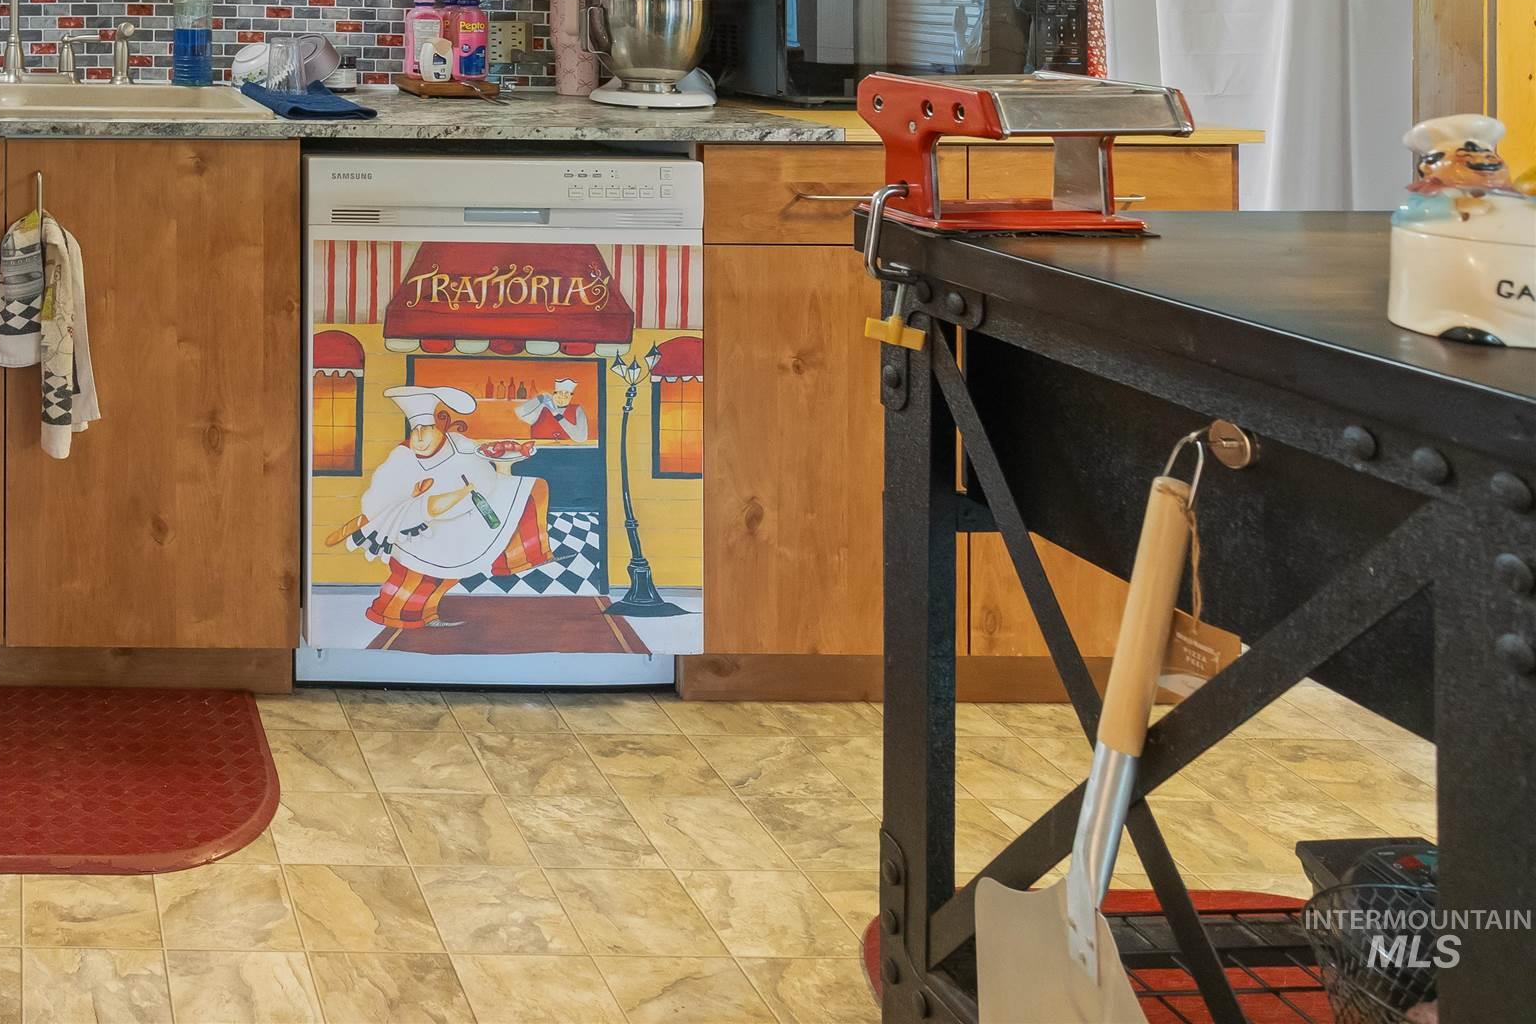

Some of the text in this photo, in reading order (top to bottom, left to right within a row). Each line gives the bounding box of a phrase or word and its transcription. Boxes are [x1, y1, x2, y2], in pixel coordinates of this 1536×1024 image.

[459, 20, 485, 32] Pepto
[331, 172, 373, 180] SAMSUNG
[406, 264, 611, 313] TRATTORIA
